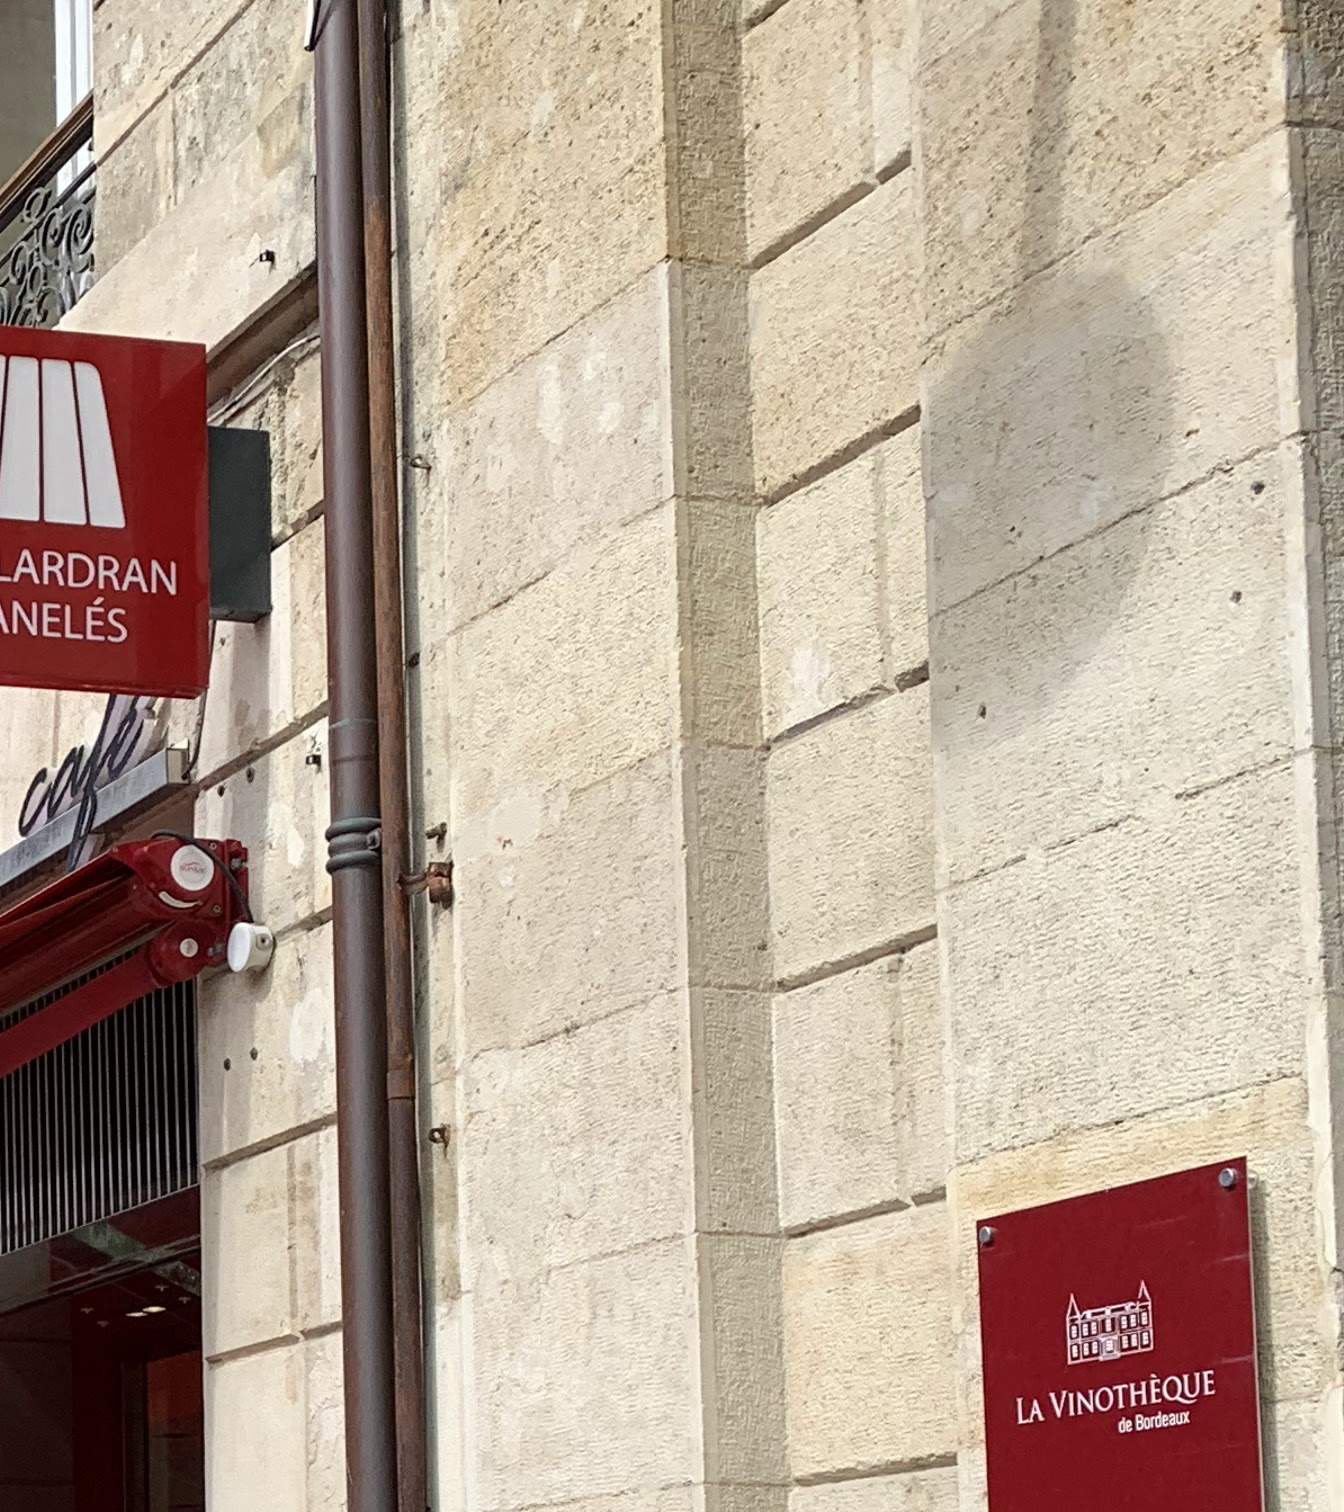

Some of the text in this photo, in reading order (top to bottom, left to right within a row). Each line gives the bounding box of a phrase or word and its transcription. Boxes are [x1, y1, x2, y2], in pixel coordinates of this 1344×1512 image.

[1016, 1368, 1217, 1426] LA VINOTHÈQUE
[1118, 1408, 1191, 1434] de Bordeaux
